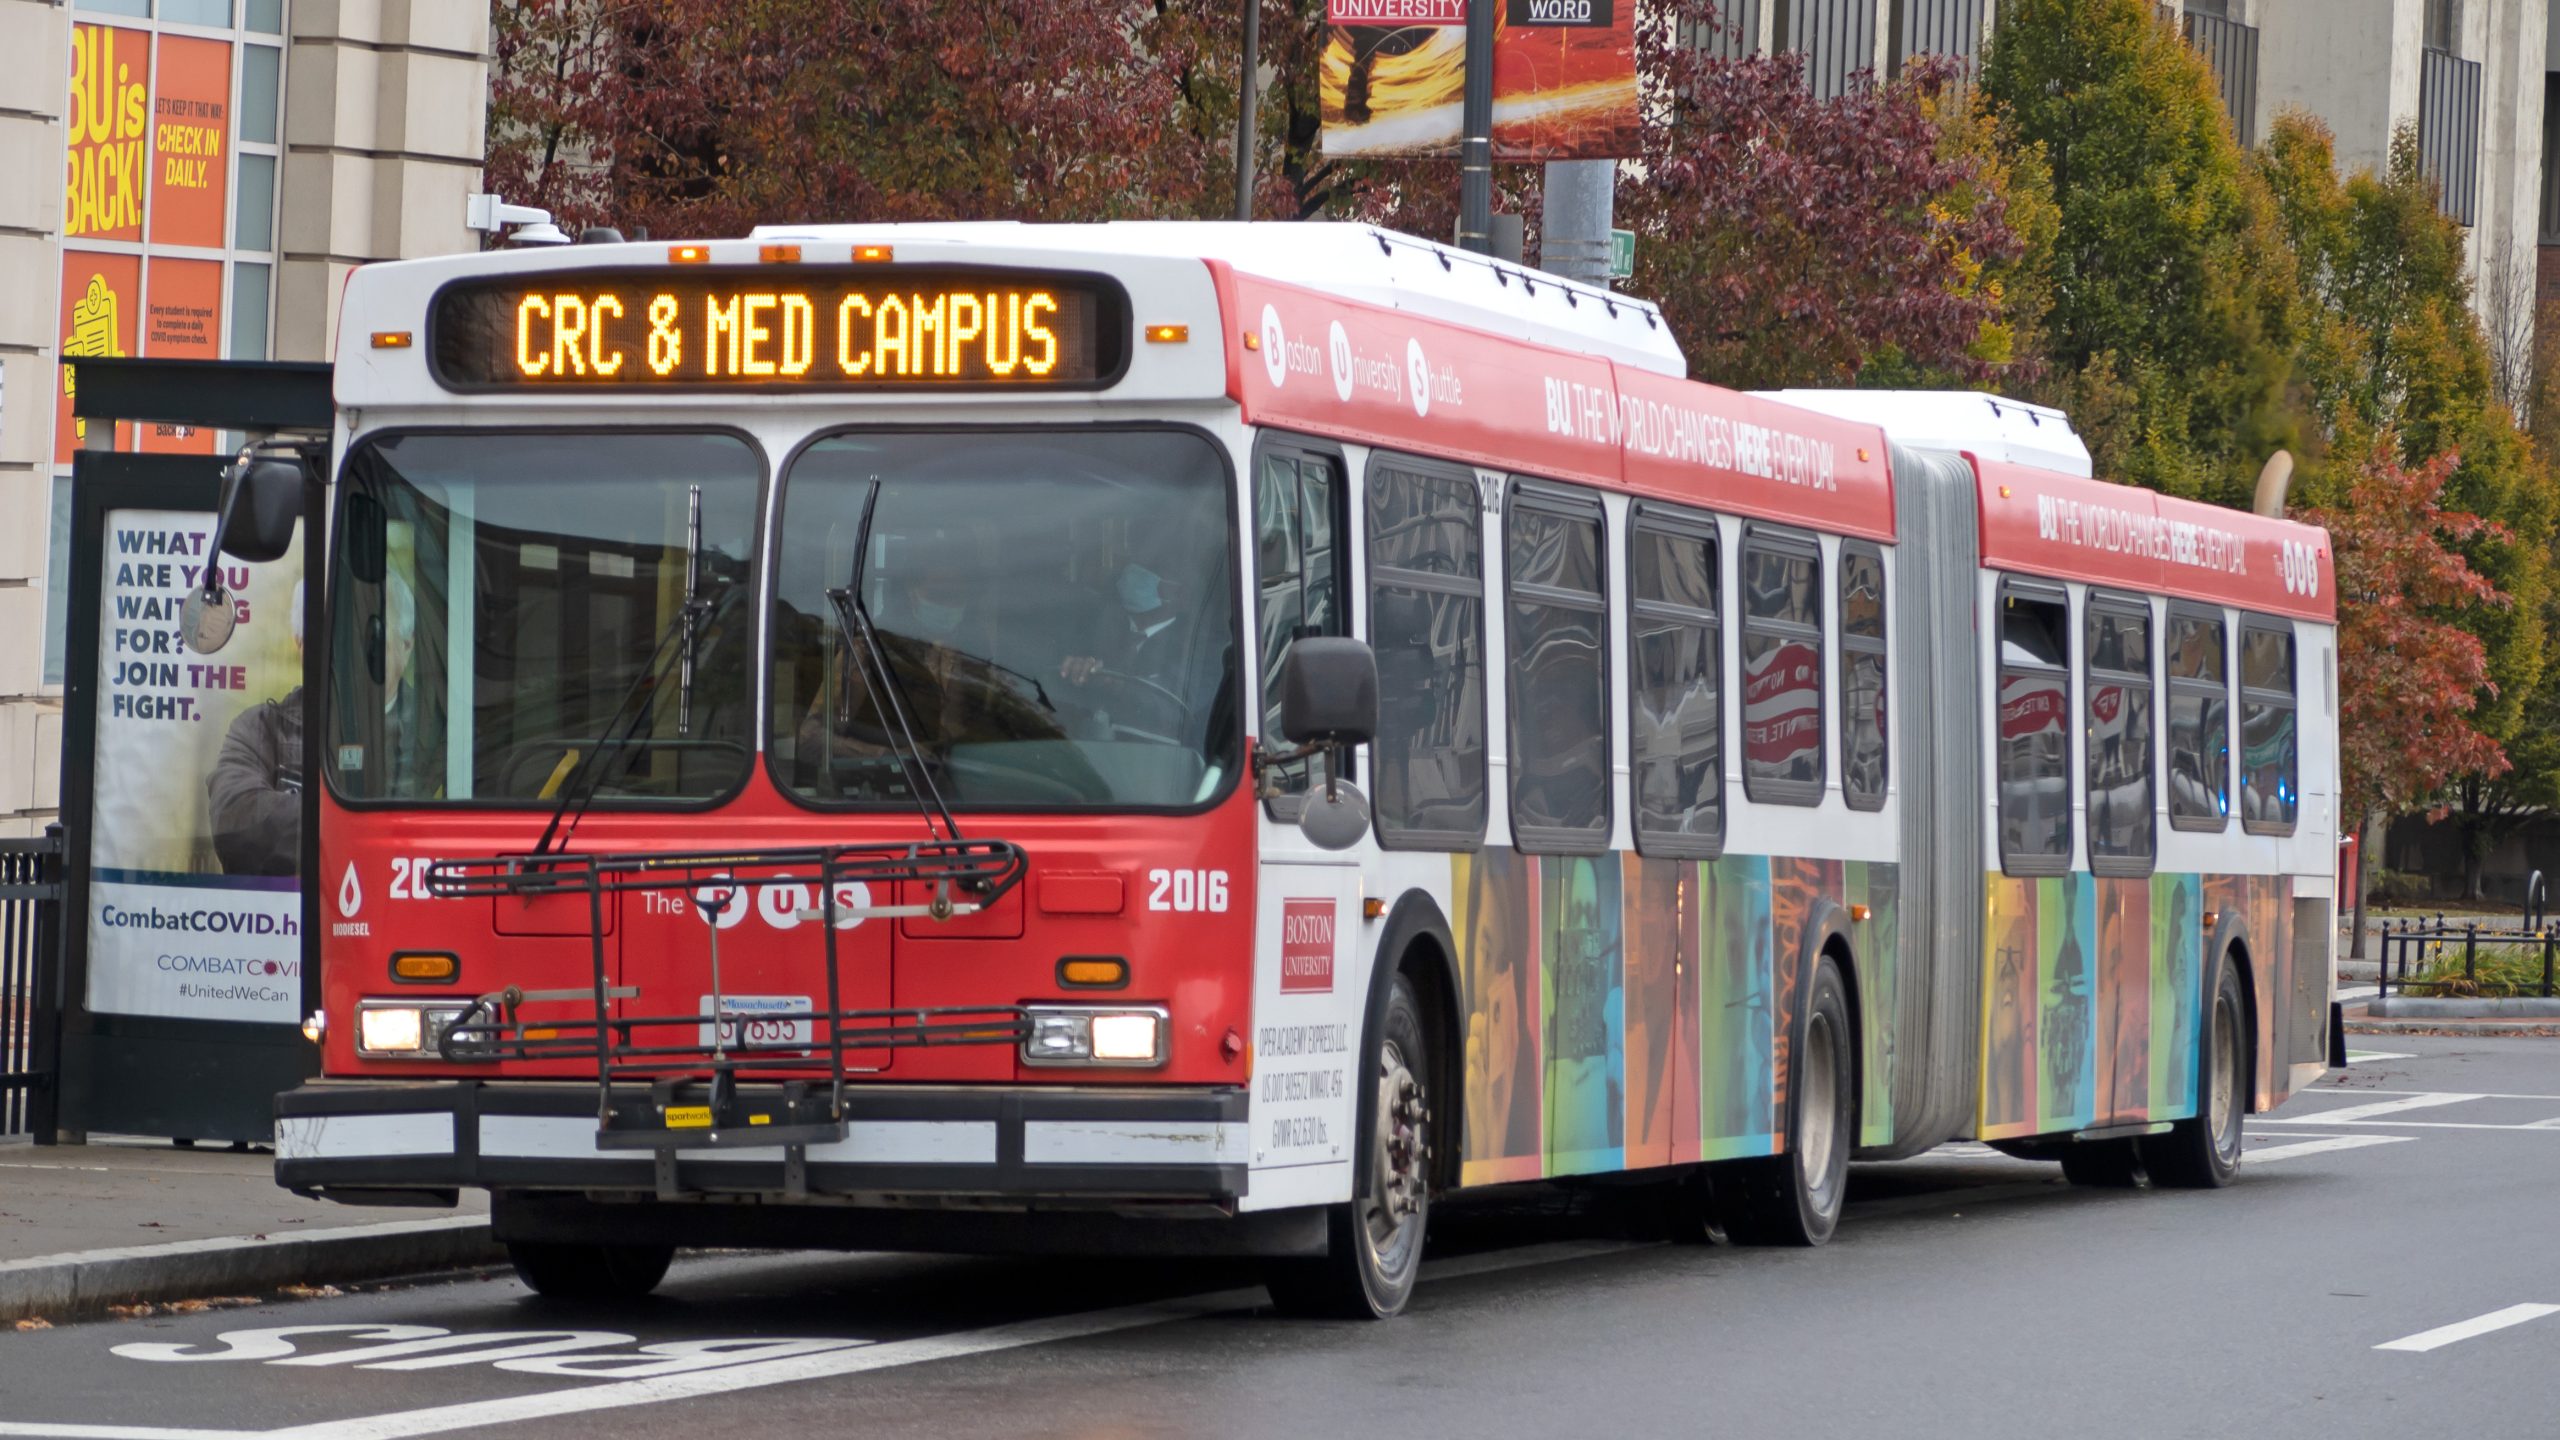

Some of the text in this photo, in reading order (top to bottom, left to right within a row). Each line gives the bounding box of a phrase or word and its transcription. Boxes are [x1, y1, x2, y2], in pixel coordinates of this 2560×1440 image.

[1332, 0, 1461, 17] UNIVERSITY
[1529, 0, 1590, 18] WORD
[68, 26, 146, 146] BU is
[155, 98, 171, 114] LET'S
[172, 99, 186, 116] KEEP
[188, 101, 194, 117] IT
[195, 102, 209, 118] THAT
[157, 124, 220, 156] CHECK IN
[65, 140, 144, 235] BACK!
[165, 158, 208, 188] DAILY.
[150, 304, 164, 317] Every
[166, 306, 185, 316] student
[191, 307, 213, 319] required
[518, 292, 1058, 375] CRC & MED CAMPUS
[1335, 341, 1401, 403] University
[1414, 358, 1463, 406] Shuttle
[1545, 376, 1574, 437] BU.
[1573, 383, 1606, 444] THE
[1605, 390, 1662, 455] WORLD
[1662, 403, 1732, 470] CHANGES
[1732, 420, 1772, 479] HERE
[1772, 430, 1809, 487] EVERY
[1481, 475, 1500, 515] 2016
[117, 530, 206, 555] WHAT
[2057, 498, 2081, 545] THE
[2080, 503, 2120, 552] WORLD
[2120, 510, 2170, 561] CHANGES
[2170, 520, 2199, 566] HERE
[116, 563, 171, 587] ARE
[116, 595, 251, 624] WAIG
[115, 628, 185, 654] FOR?
[113, 661, 246, 690] JOIN THE
[113, 694, 201, 721] FIGHT.
[641, 891, 683, 914] The
[1148, 869, 1228, 912] 2016
[333, 922, 370, 937] BIODIESEL
[1286, 915, 1332, 944] BOSTON
[157, 954, 301, 977] COMBATCOVI
[1285, 955, 1330, 976] UNIVERSITY
[179, 983, 289, 1002] #UnitedWeCan
[726, 999, 788, 1010] Massachusetts
[1277, 1026, 1308, 1056] ACADEMY
[1308, 1024, 1335, 1054] EXPRESS
[1262, 1074, 1270, 1103] US
[1272, 1073, 1284, 1102] DOT
[1310, 1070, 1330, 1099] WMATC
[1273, 1119, 1291, 1148] GVWR
[109, 1324, 877, 1379] BUS
